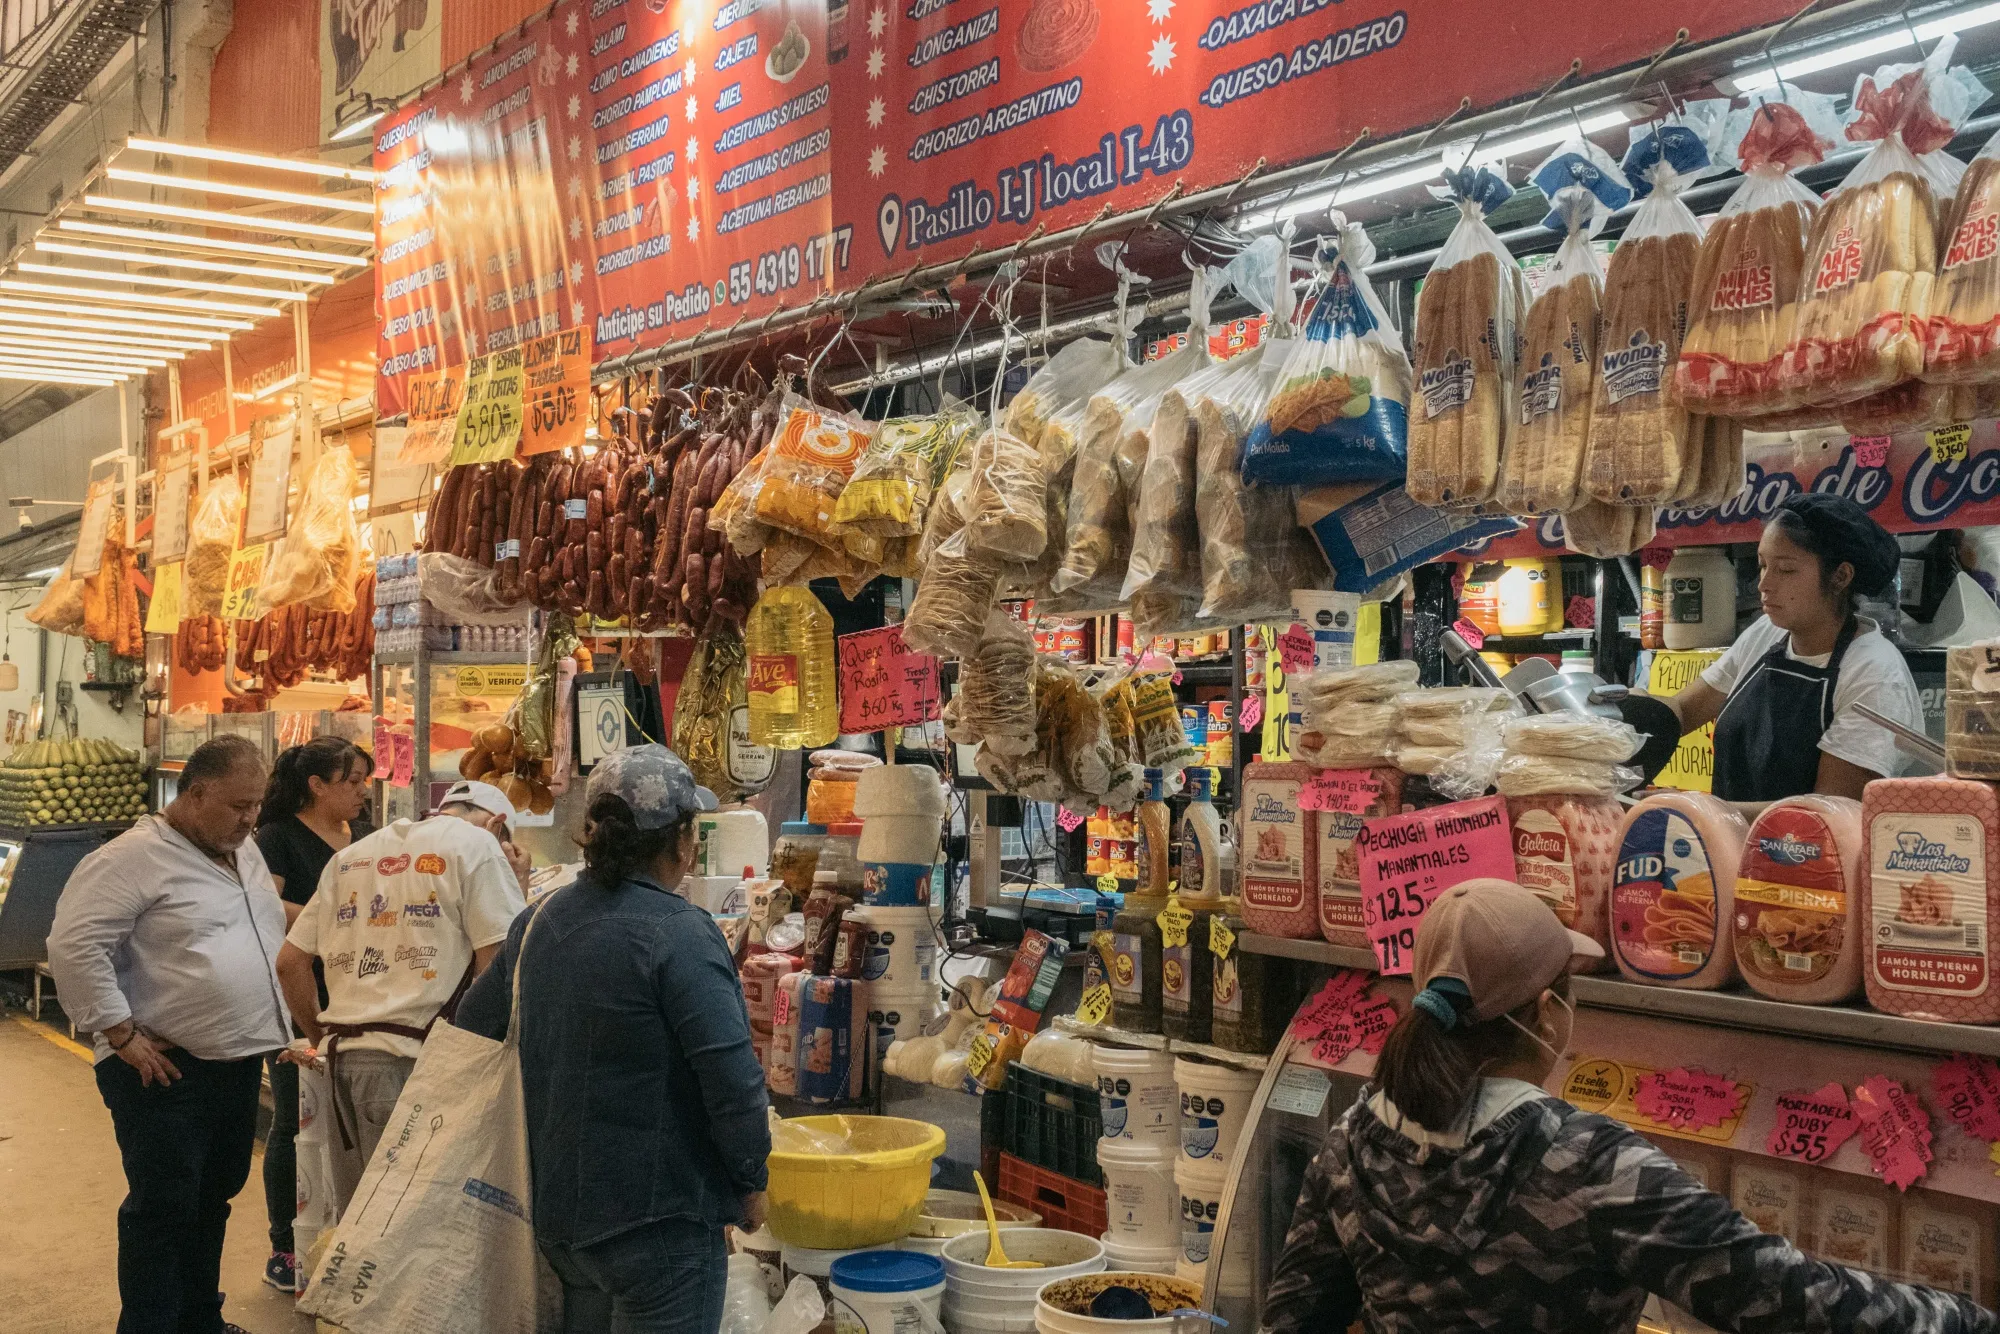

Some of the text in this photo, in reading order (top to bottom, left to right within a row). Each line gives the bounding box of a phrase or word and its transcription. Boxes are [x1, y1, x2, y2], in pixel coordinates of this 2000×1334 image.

[908, 9, 998, 67] -LONGANIZA
[508, 42, 538, 73] PIERNA
[590, 32, 680, 92] -LOMO CANADIENSE
[714, 34, 758, 71] -CAJETA
[1202, 15, 1404, 105] -QUESO ASADERO
[509, 85, 531, 110] PAVO
[715, 83, 742, 112] -MIEL
[909, 59, 999, 113] -CHISTORRA
[590, 72, 683, 130] -CHORIZO PAMPLONA
[625, 117, 669, 148] SERRANO
[714, 115, 777, 153] -ACEITUNAS
[909, 79, 1081, 161] -CHORIZO ARGENTINO
[637, 154, 674, 180] PASTOR
[715, 155, 778, 193] -ACEITUNAS
[909, 116, 1190, 245] Pasillo I-J local I-43
[717, 173, 831, 233] -ACEITUNA REBANADA
[596, 227, 852, 343] Anticipe su Pedido 55 4319 1777
[186, 357, 296, 422] NUTRIEND ESENCIA
[531, 386, 567, 436] $50
[1363, 435, 1376, 451] kg
[844, 633, 913, 668] Queso Pan
[488, 678, 527, 686] VERIFICA
[752, 663, 787, 684] Ave
[851, 668, 888, 691] Rosita
[860, 696, 888, 721] $60
[1251, 807, 1295, 823] Manantiales
[1267, 799, 1283, 813] Los
[1359, 808, 1502, 857] PECHUGA AHUMADA
[1518, 832, 1560, 855] Galicia
[1761, 838, 1817, 857] SAN RAFAEL
[1917, 840, 1945, 856] Los
[1378, 844, 1470, 881] MANANTIALES
[1616, 856, 1663, 884] FUD
[1887, 853, 1970, 873] Manantiales
[1253, 893, 1293, 903] HORNEADO
[1276, 886, 1299, 894] PIERNA
[1366, 880, 1425, 927] $125
[1617, 895, 1655, 905] DE PIERNA
[1780, 888, 1838, 910] PIERNA
[403, 903, 441, 918] MEGA
[1331, 911, 1364, 924] HORNEA
[1881, 955, 1978, 973] JAMÓN DE PIERNA
[1892, 968, 1967, 984] HORNEADO
[1569, 1084, 1612, 1100] amarillo
[1574, 1074, 1609, 1088] El sello
[1776, 1095, 1851, 1121] MORTADELA
[398, 1103, 423, 1147] FERTICO
[1785, 1113, 1833, 1133] DUBY
[1774, 1129, 1828, 1162] $55
[321, 1241, 347, 1286] MAP
[350, 1259, 378, 1306] MAP
